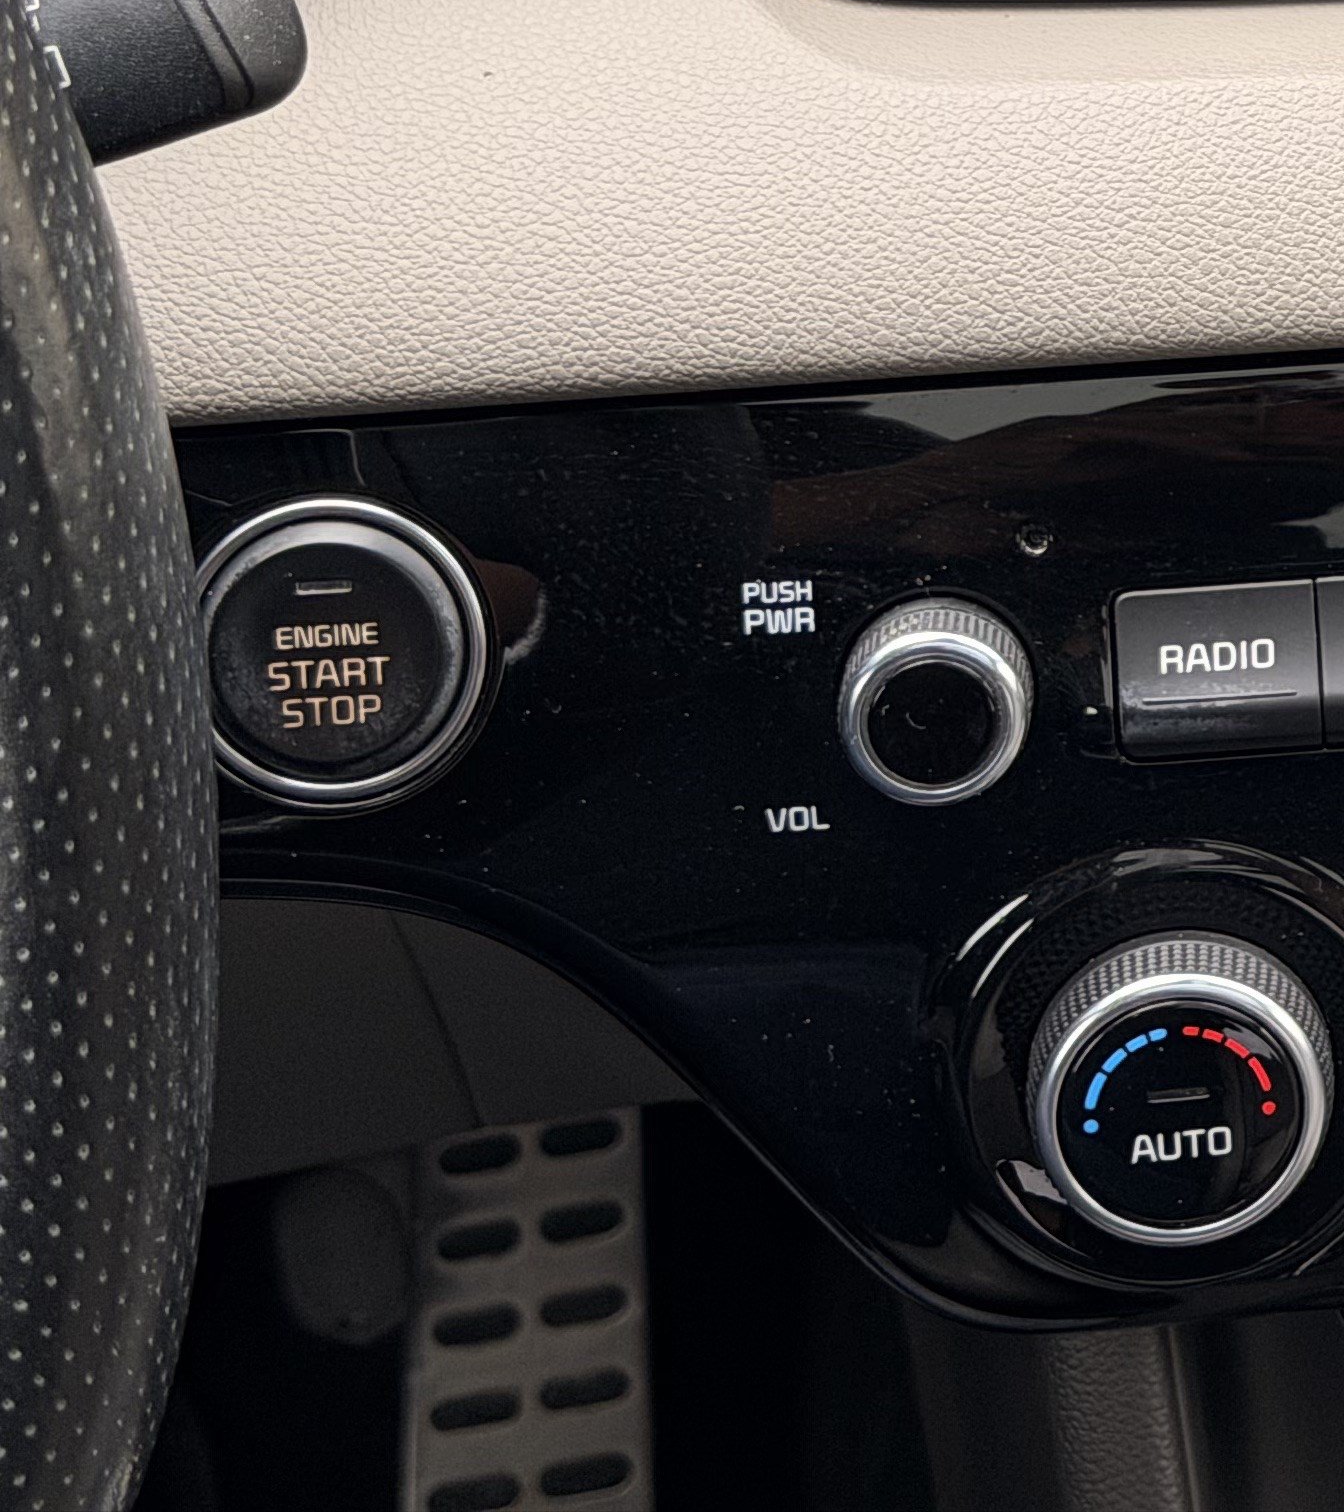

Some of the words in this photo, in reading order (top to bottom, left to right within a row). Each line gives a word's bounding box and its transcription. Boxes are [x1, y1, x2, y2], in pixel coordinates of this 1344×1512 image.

[742, 580, 813, 604] PUSH
[274, 622, 380, 650] ENGINE
[743, 607, 816, 635] PWR
[1159, 638, 1276, 675] RADIO
[267, 655, 391, 692] START
[282, 694, 382, 728] STOP
[765, 806, 831, 833] VOL
[1131, 1126, 1234, 1165] AUTO
